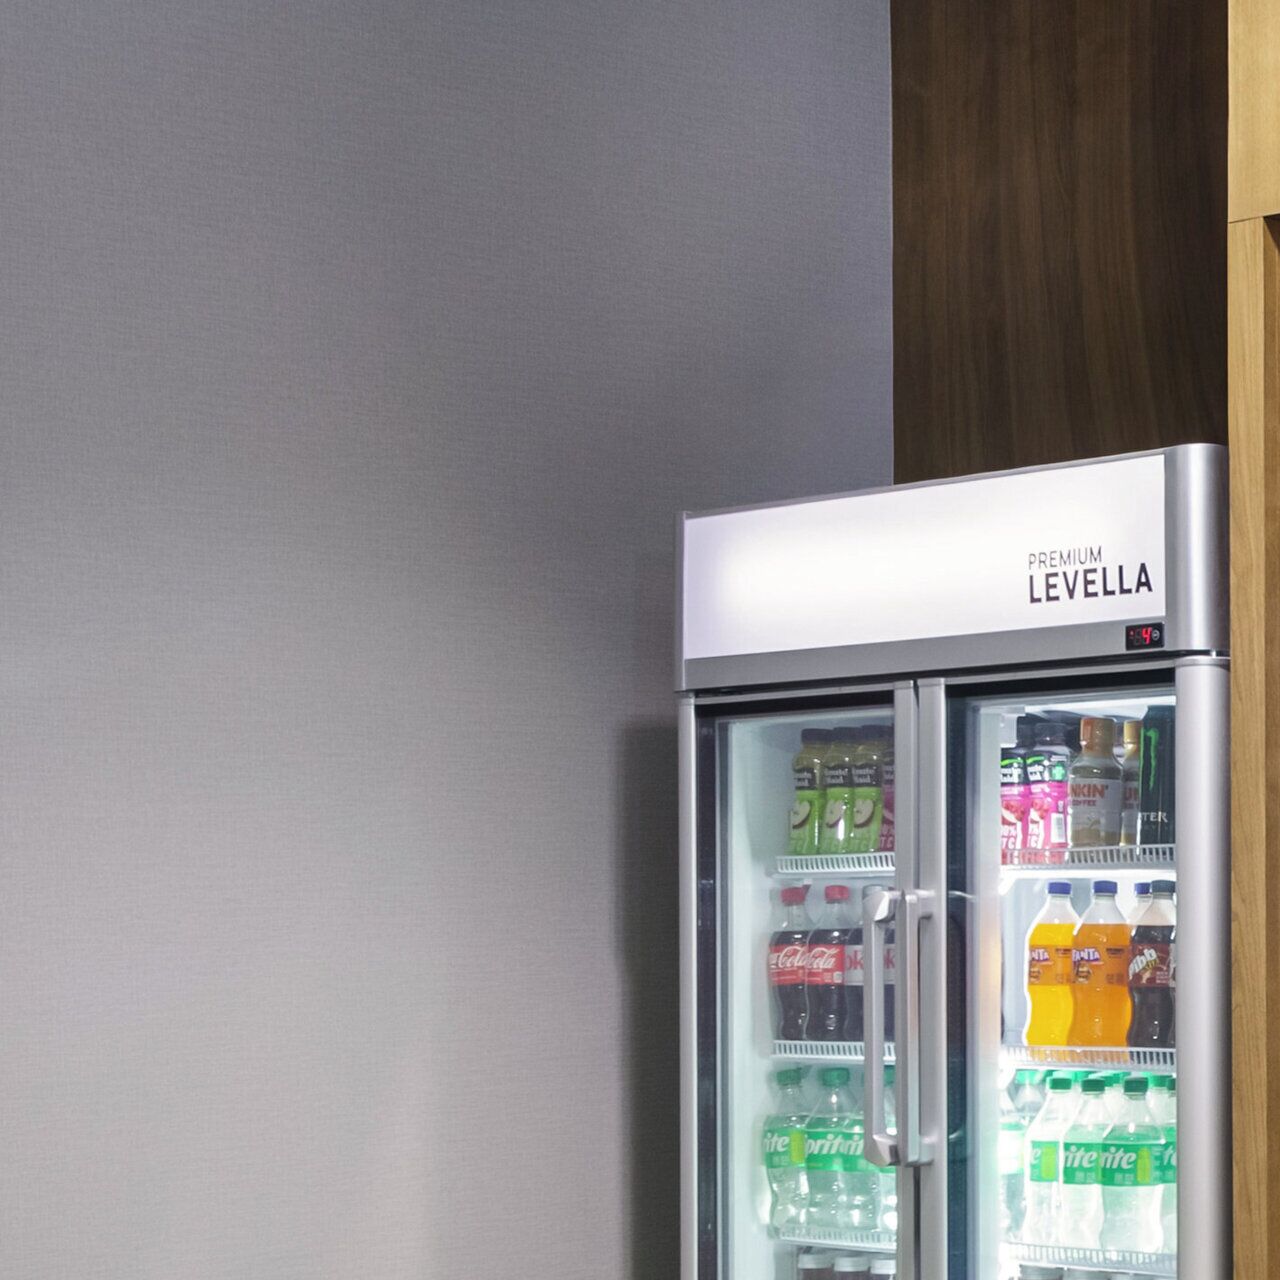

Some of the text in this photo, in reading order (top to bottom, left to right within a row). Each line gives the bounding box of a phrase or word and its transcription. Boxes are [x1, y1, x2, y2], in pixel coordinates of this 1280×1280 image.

[1028, 545, 1103, 571] PREMIUM
[1029, 562, 1154, 604] LEVELLA
[1030, 948, 1049, 961] NTA
